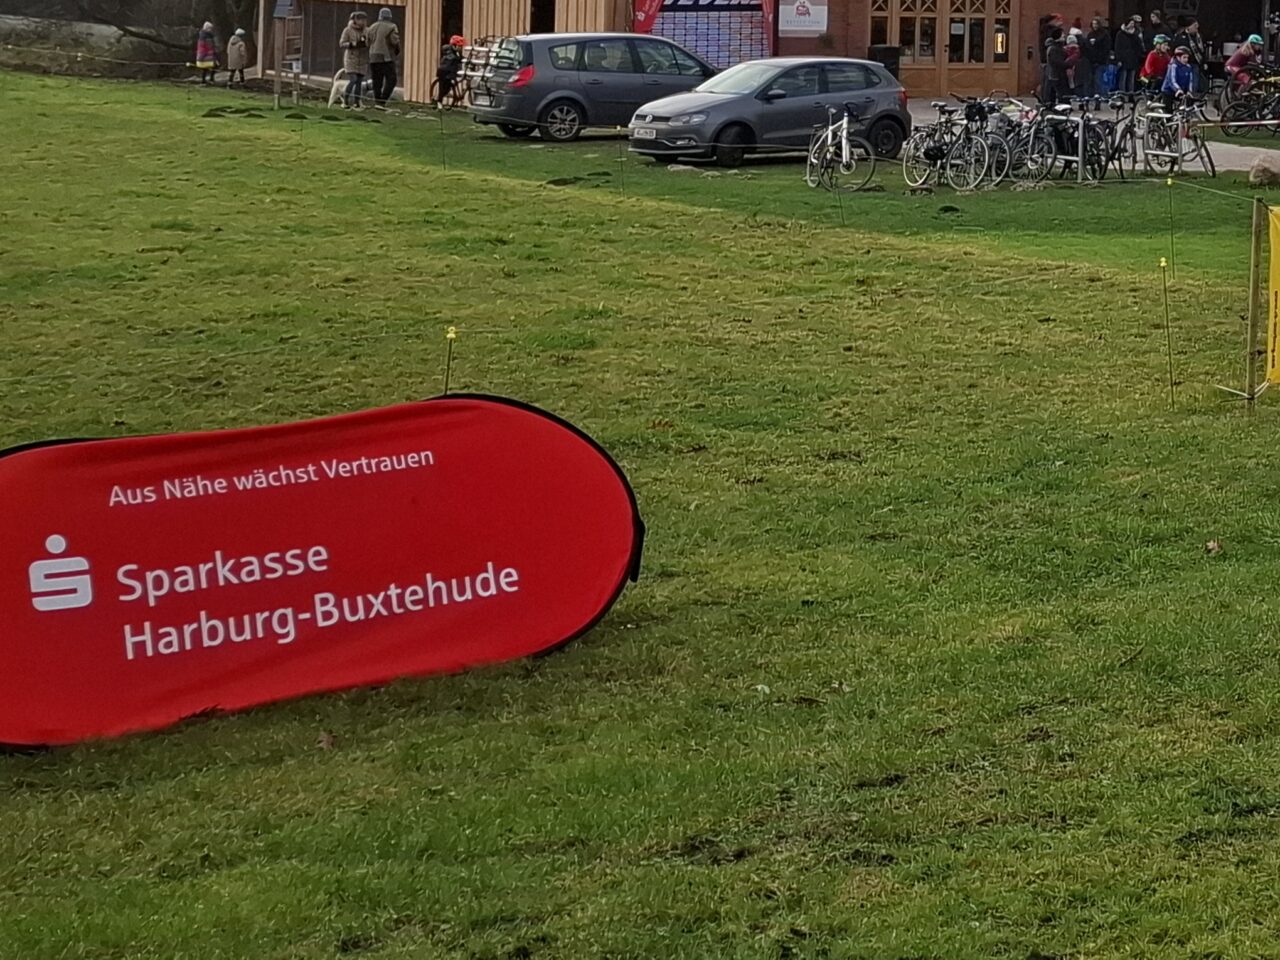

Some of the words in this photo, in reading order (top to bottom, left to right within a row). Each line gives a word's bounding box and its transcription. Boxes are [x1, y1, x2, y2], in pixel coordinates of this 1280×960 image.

[109, 485, 157, 507] Aus
[163, 475, 228, 500] Nähe
[233, 465, 320, 492] wächst
[320, 450, 434, 479] Vertrauen
[116, 544, 329, 606] Sparkasse
[123, 561, 520, 661] Harburg-Buxtehude
